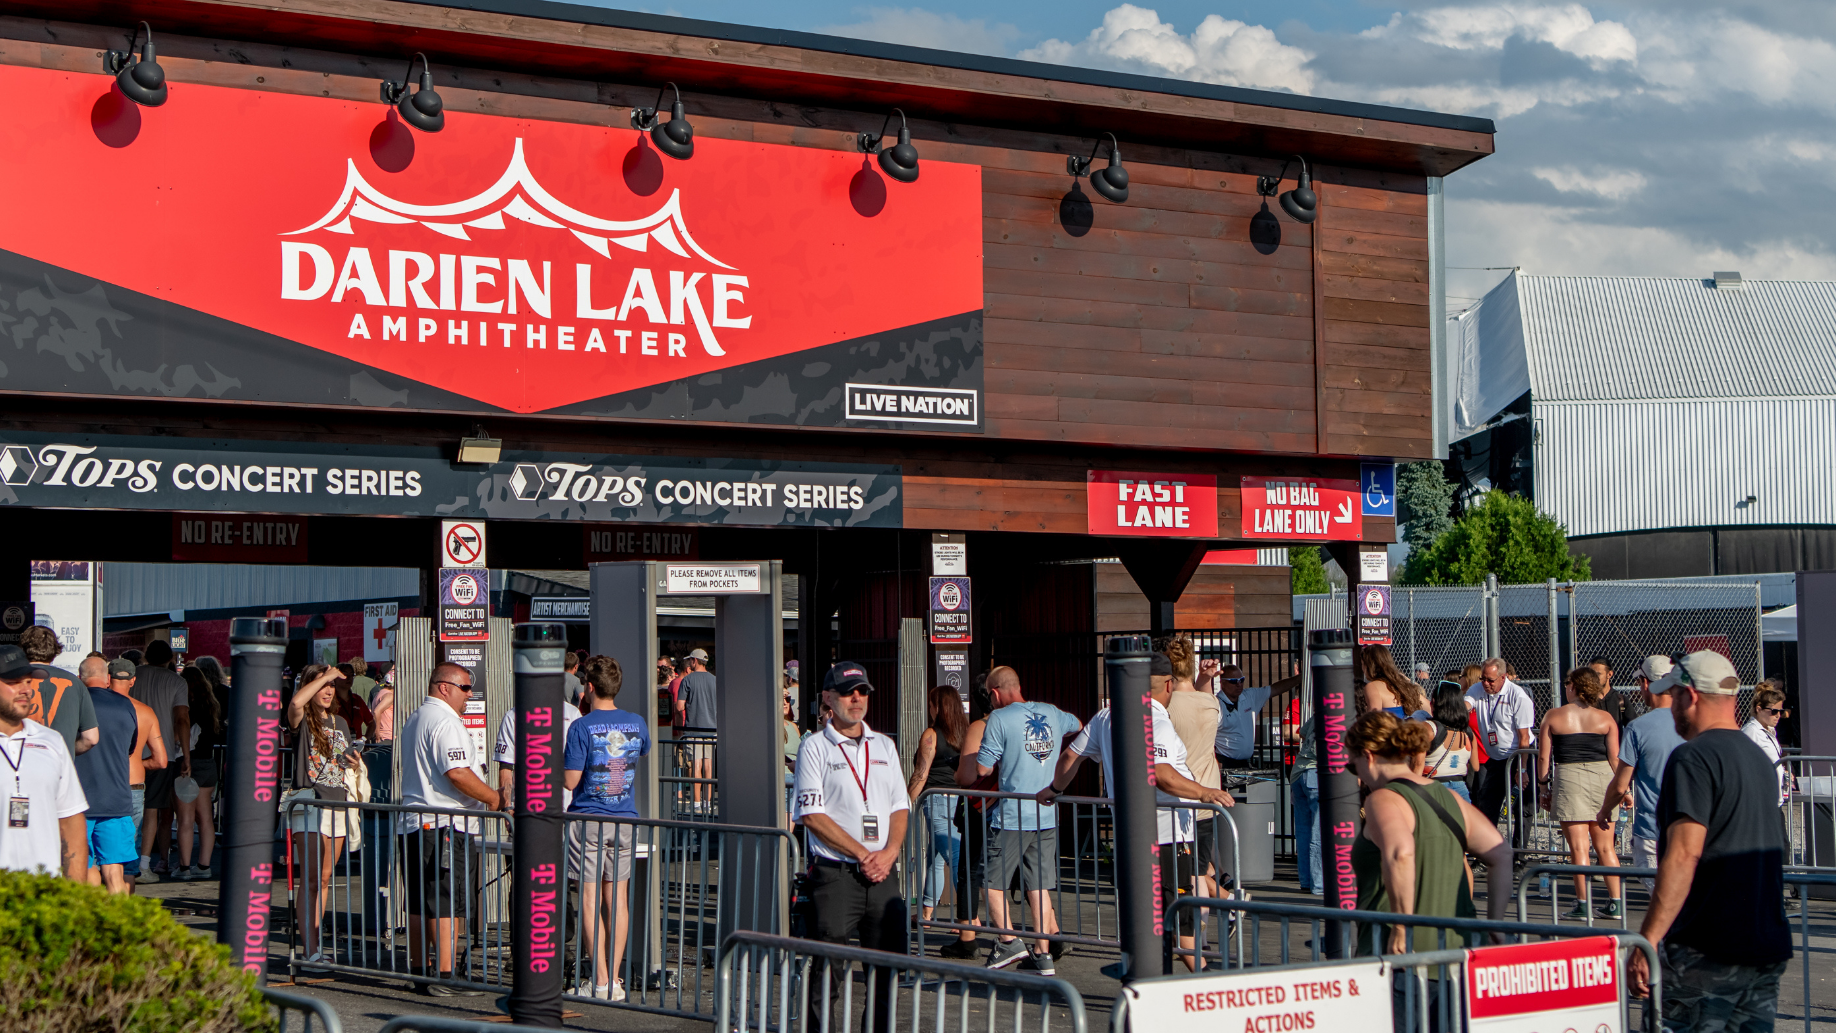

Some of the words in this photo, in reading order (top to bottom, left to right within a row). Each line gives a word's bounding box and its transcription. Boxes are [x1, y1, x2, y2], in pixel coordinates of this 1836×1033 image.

[279, 242, 552, 318] DARIEN
[576, 264, 753, 357] LAKE
[348, 314, 687, 357] AMPHITHEATER
[854, 393, 897, 412] LIVE
[900, 395, 970, 416] NATION
[172, 463, 318, 494] CONCERT
[326, 468, 422, 496] SERIES
[1118, 479, 1187, 503] FAST
[655, 479, 776, 507] CONCERT
[783, 484, 864, 510] SERIES
[1265, 481, 1286, 505] NO
[1289, 482, 1319, 507] BAG
[1117, 505, 1190, 529] LANE
[1254, 508, 1292, 534] LANE
[1295, 509, 1330, 535] ONLY
[181, 520, 206, 544] NO
[211, 521, 300, 547] RE-ENTRY
[591, 531, 612, 552] NO
[616, 532, 692, 555] RE-ENTRY
[670, 569, 694, 578] PLEASE
[696, 569, 722, 578] REMOVE
[723, 569, 736, 577] ALL
[737, 569, 757, 577] ITEMS
[689, 580, 707, 588] FROM
[709, 579, 739, 588] POCKETS
[455, 588, 473, 597] WiFi
[942, 594, 958, 603] WiFi
[364, 605, 383, 617] FIRST
[384, 604, 397, 616] AID
[445, 608, 475, 620] CONNECT
[475, 608, 485, 620] TO
[533, 602, 551, 615] ARTIST
[552, 602, 590, 616] MERCHANDISE
[1368, 601, 1381, 609] WiFi
[934, 613, 959, 624] CONNECT
[960, 613, 967, 623] TO
[1361, 617, 1380, 627] CONNECT
[1381, 617, 1388, 627] TO
[61, 627, 80, 635] EASY
[65, 636, 75, 644] TO
[62, 644, 82, 652] NJOY
[447, 750, 467, 762] 5971
[1324, 715, 1346, 774] Mobile
[254, 717, 280, 802] Mobile
[525, 732, 552, 813] Mobile
[1335, 842, 1358, 910] Mobile
[243, 890, 271, 976] Mobile
[529, 891, 556, 974] Mobile
[1475, 965, 1568, 1000] PROHIBITED
[1572, 954, 1613, 988] ITEMS
[1183, 985, 1286, 1012] RESTRICTED
[1294, 981, 1342, 1002] ITEMS
[1347, 978, 1361, 997] &
[1244, 1011, 1315, 1033] ACTIONS
